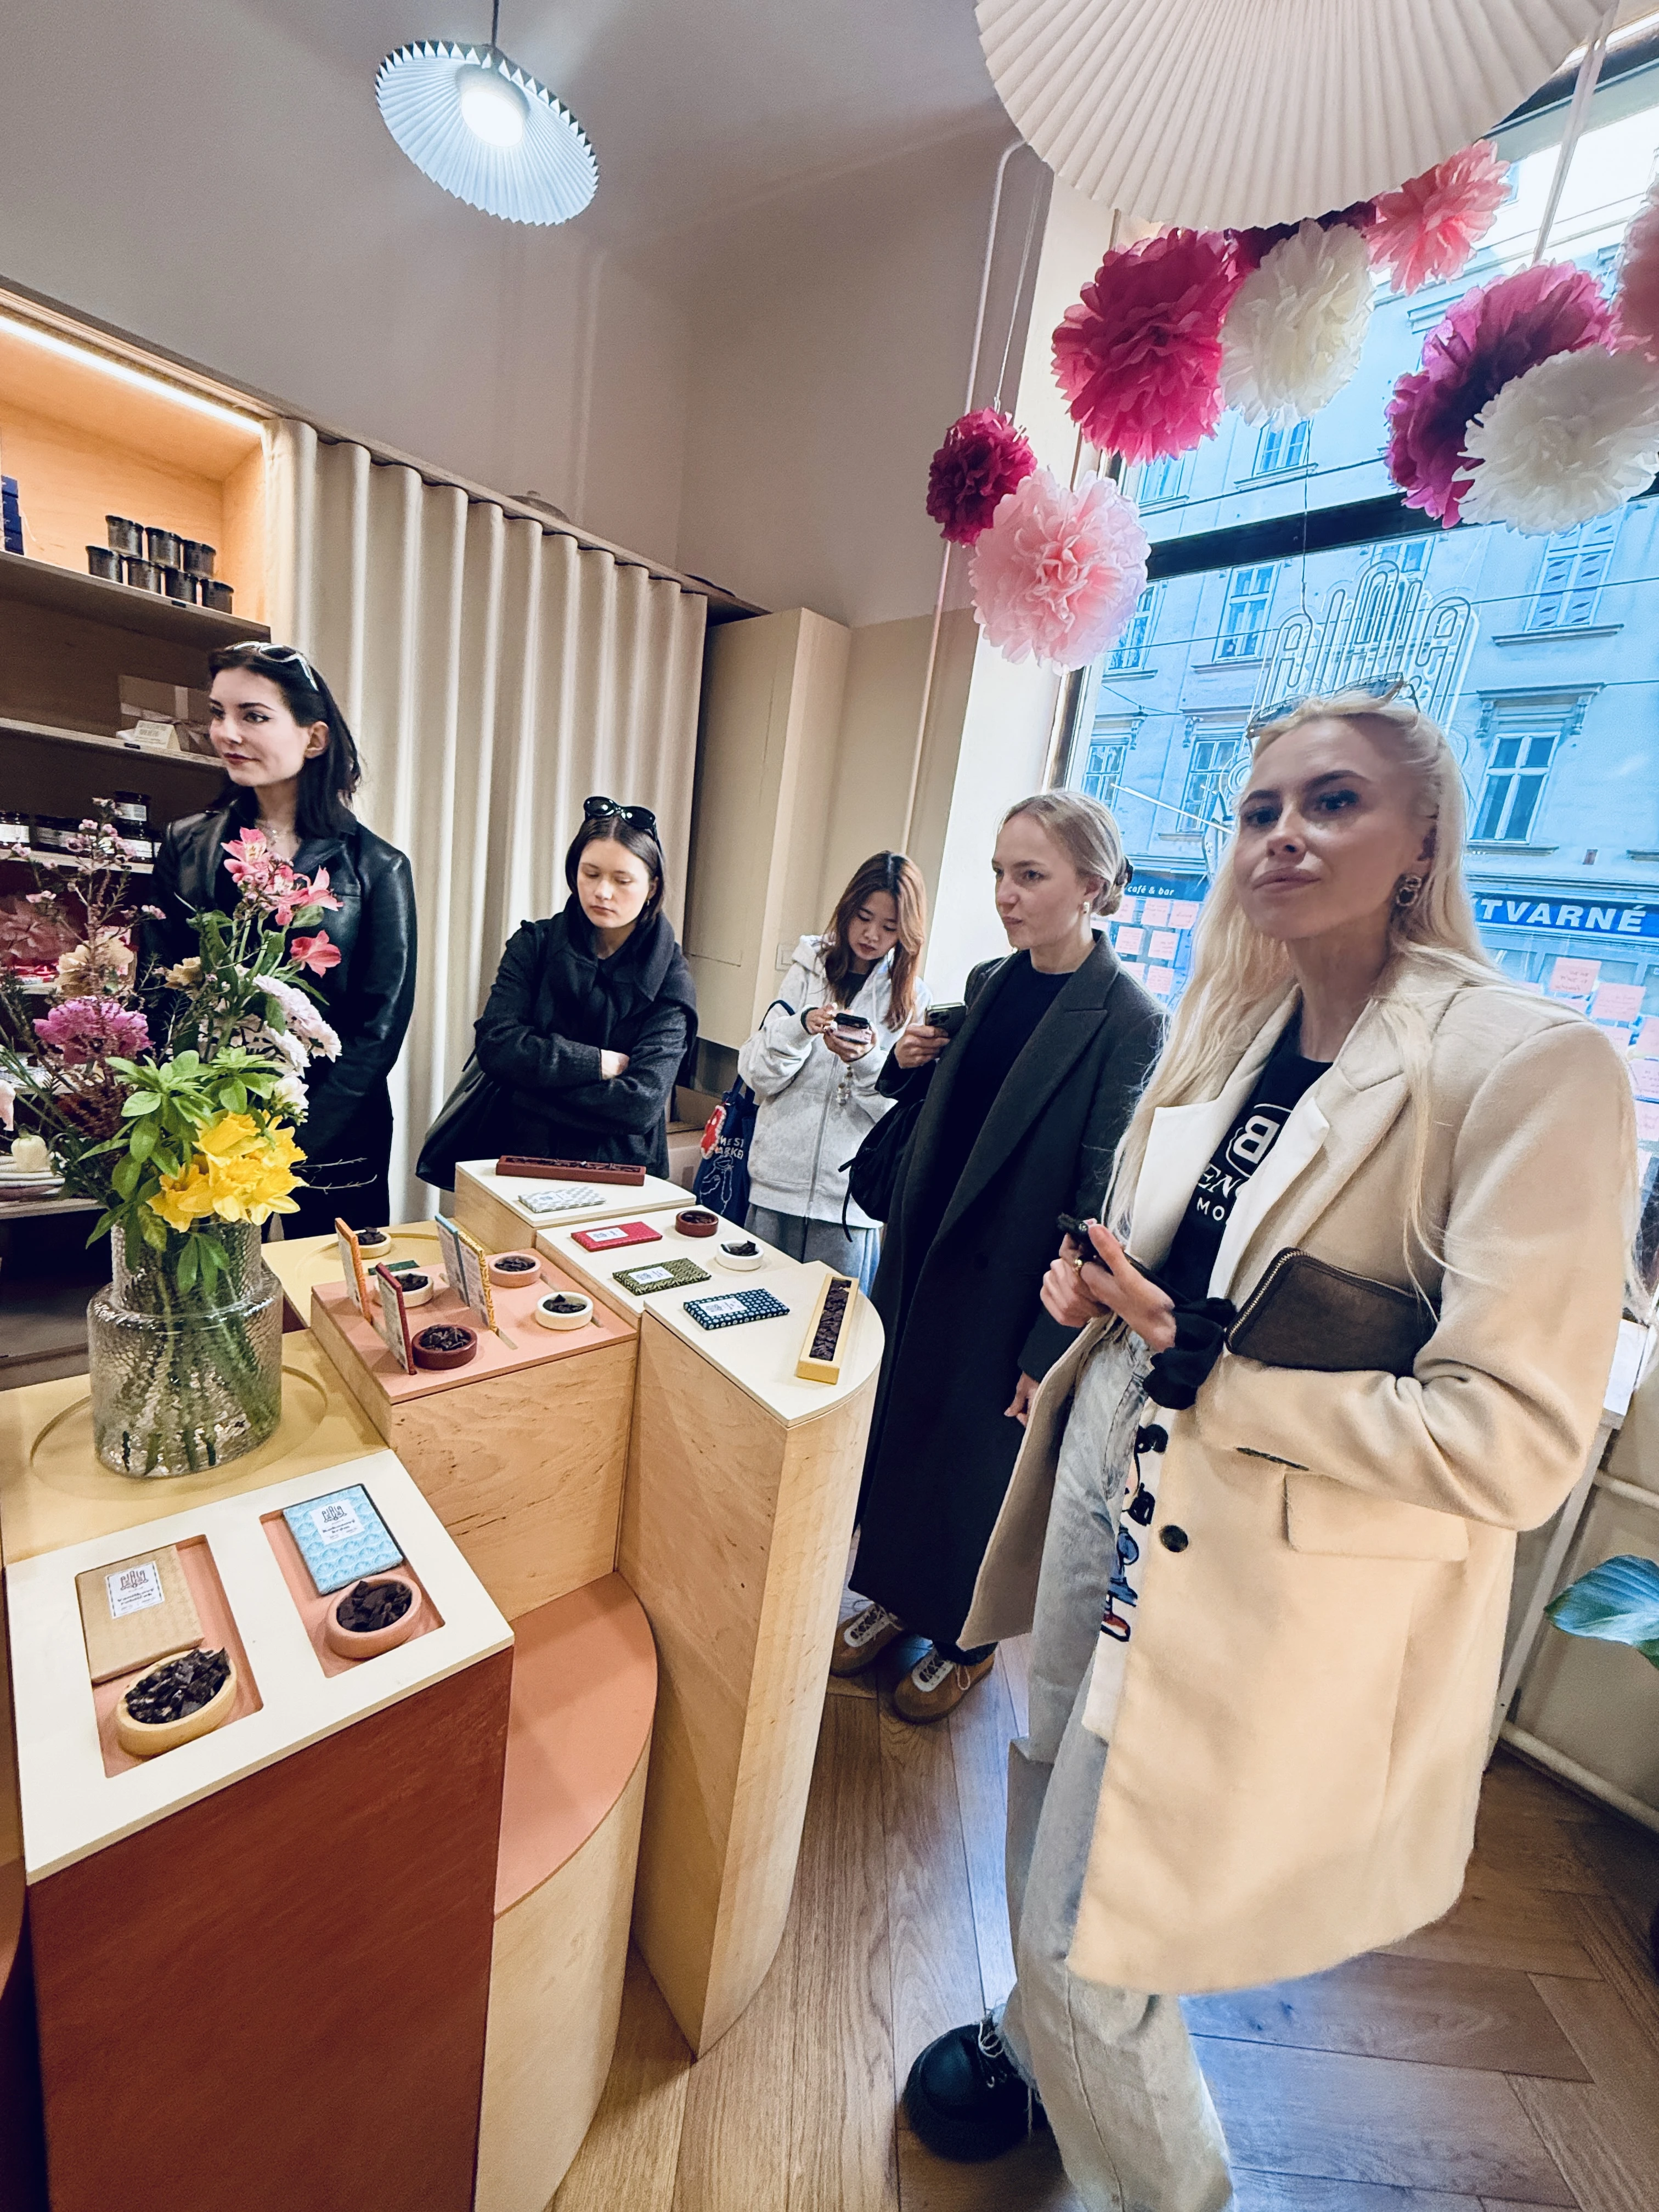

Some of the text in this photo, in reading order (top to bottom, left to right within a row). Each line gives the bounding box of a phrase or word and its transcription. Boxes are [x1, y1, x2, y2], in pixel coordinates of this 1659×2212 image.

[1127, 884, 1175, 896] café & bar
[1470, 893, 1646, 932] TVARNÉ
